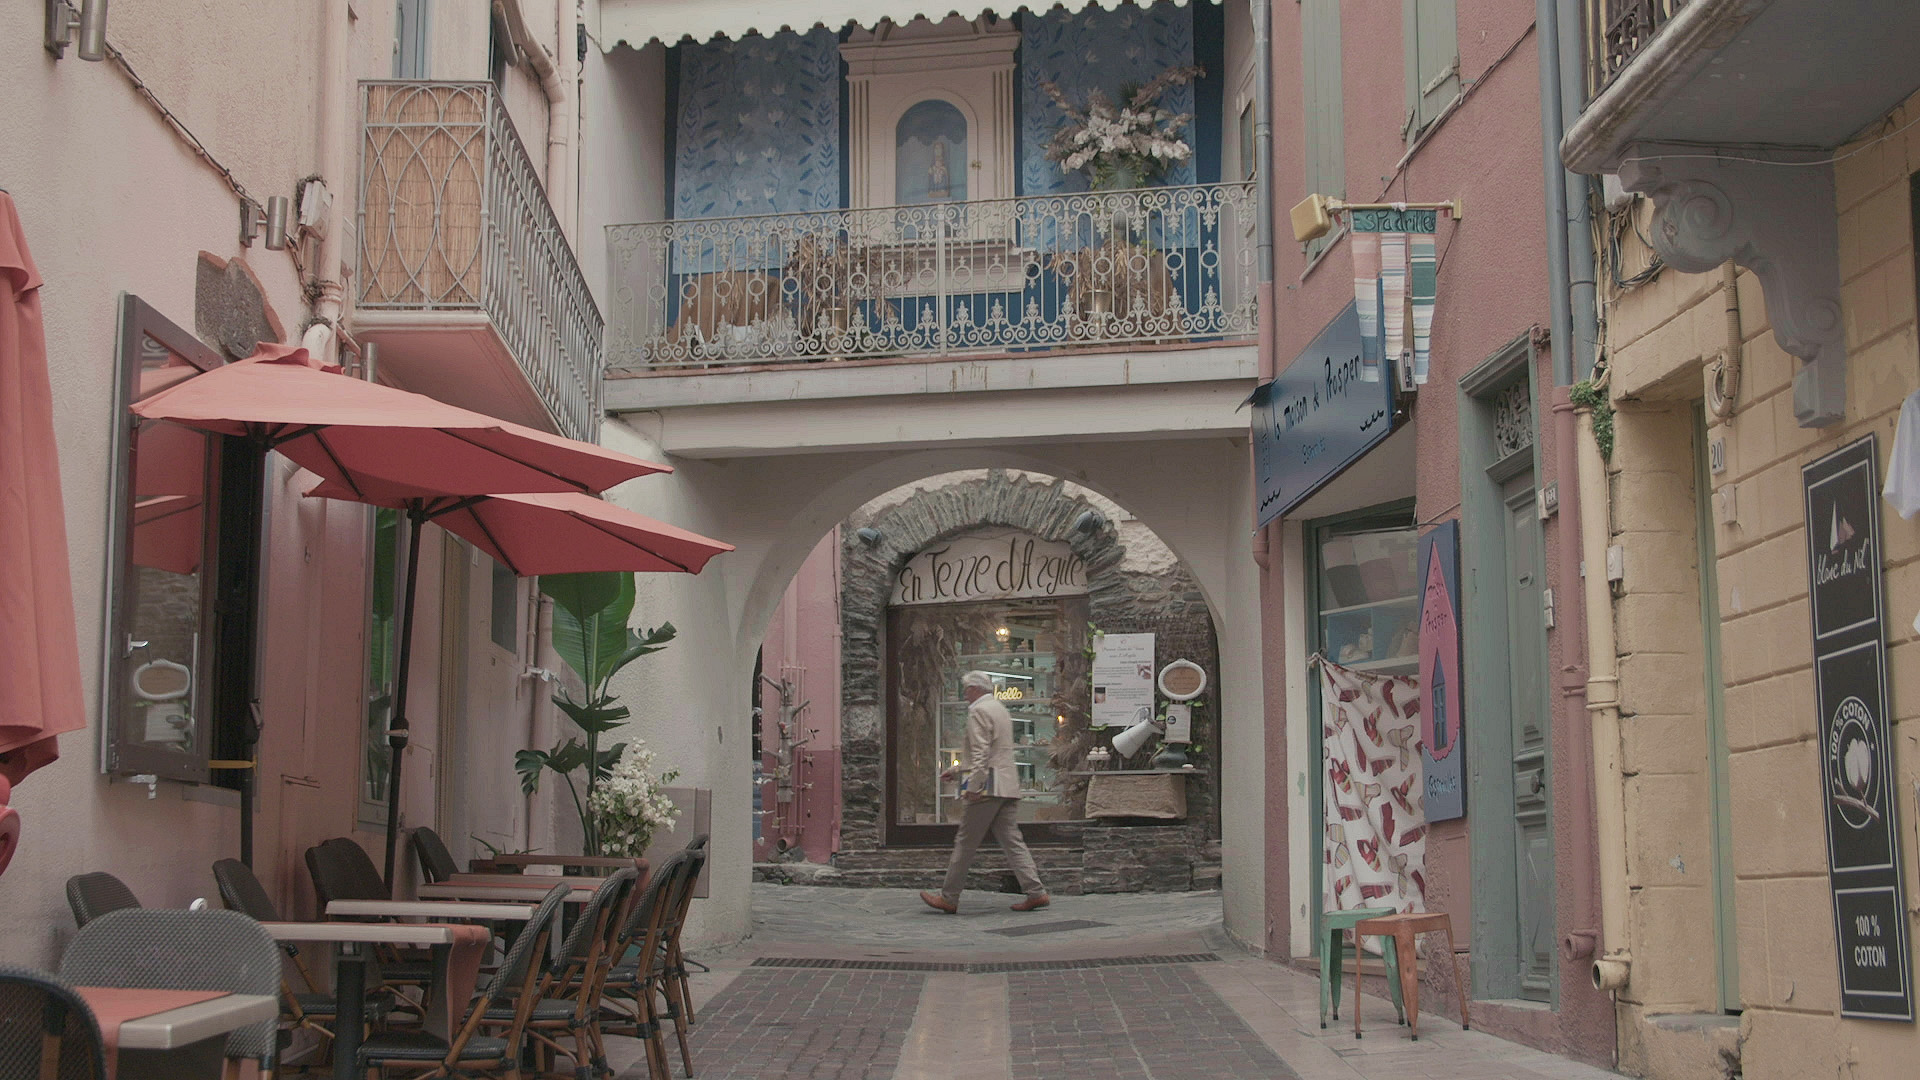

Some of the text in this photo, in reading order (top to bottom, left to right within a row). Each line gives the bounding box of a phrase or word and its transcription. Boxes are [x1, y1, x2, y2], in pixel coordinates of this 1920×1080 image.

[1324, 354, 1360, 403] Prosper
[1711, 441, 1723, 469] 20
[900, 566, 923, 603] En
[925, 544, 992, 600] Terre
[1840, 548, 1852, 577] du
[993, 683, 1023, 701] hello
[1831, 702, 1870, 760] 100 % COTON
[1855, 914, 1881, 937] 100 %
[1854, 945, 1886, 968] COTON
